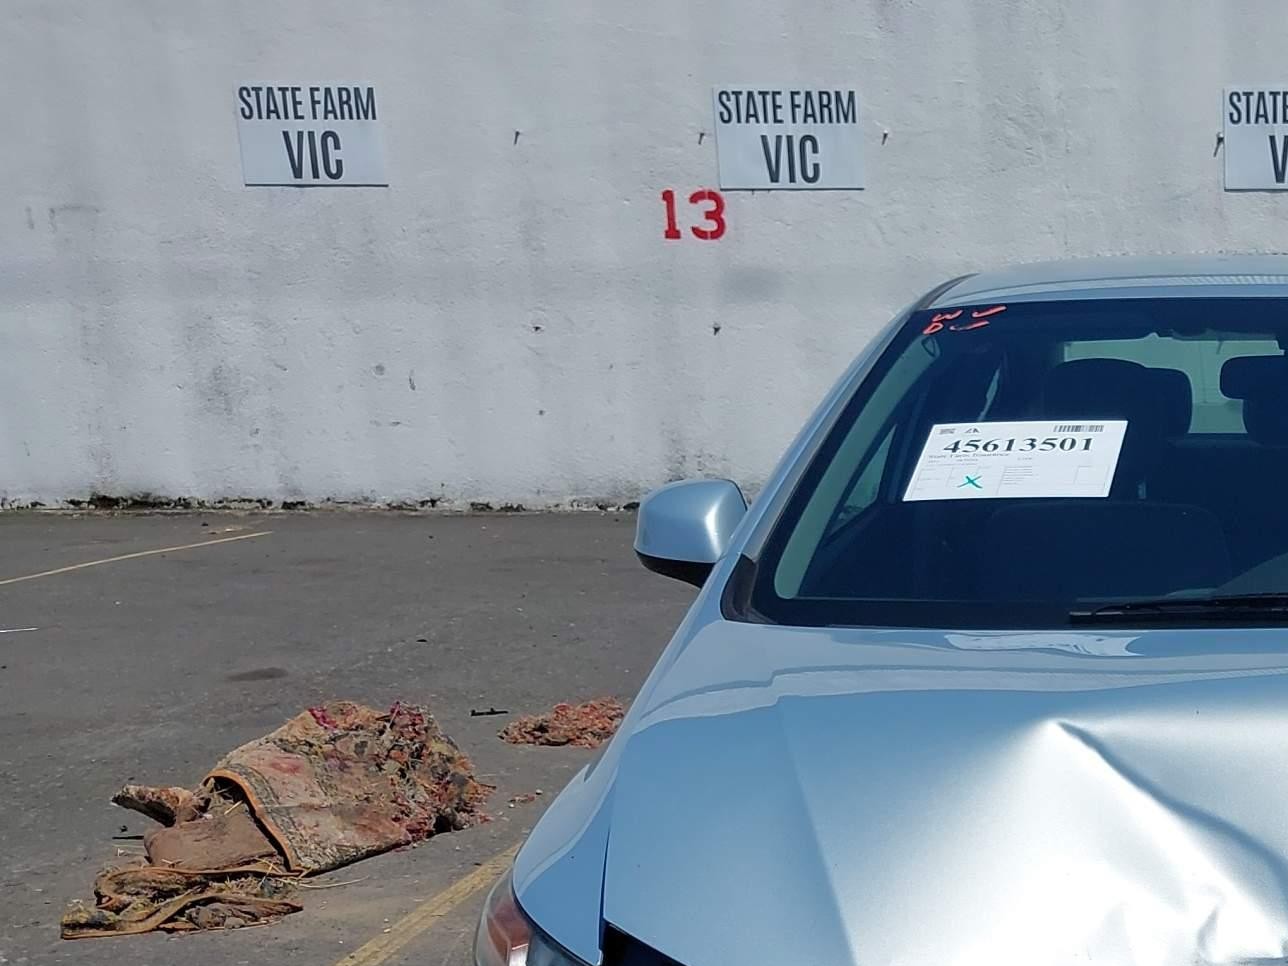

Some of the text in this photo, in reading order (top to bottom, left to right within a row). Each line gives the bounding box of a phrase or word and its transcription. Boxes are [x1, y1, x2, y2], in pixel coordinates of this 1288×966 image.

[238, 86, 377, 121] STATE FARM
[718, 90, 857, 124] STATE FARM
[282, 130, 344, 180] VIC
[760, 134, 821, 184] VIC
[660, 189, 727, 241] 13
[942, 437, 1094, 453] 45613501
